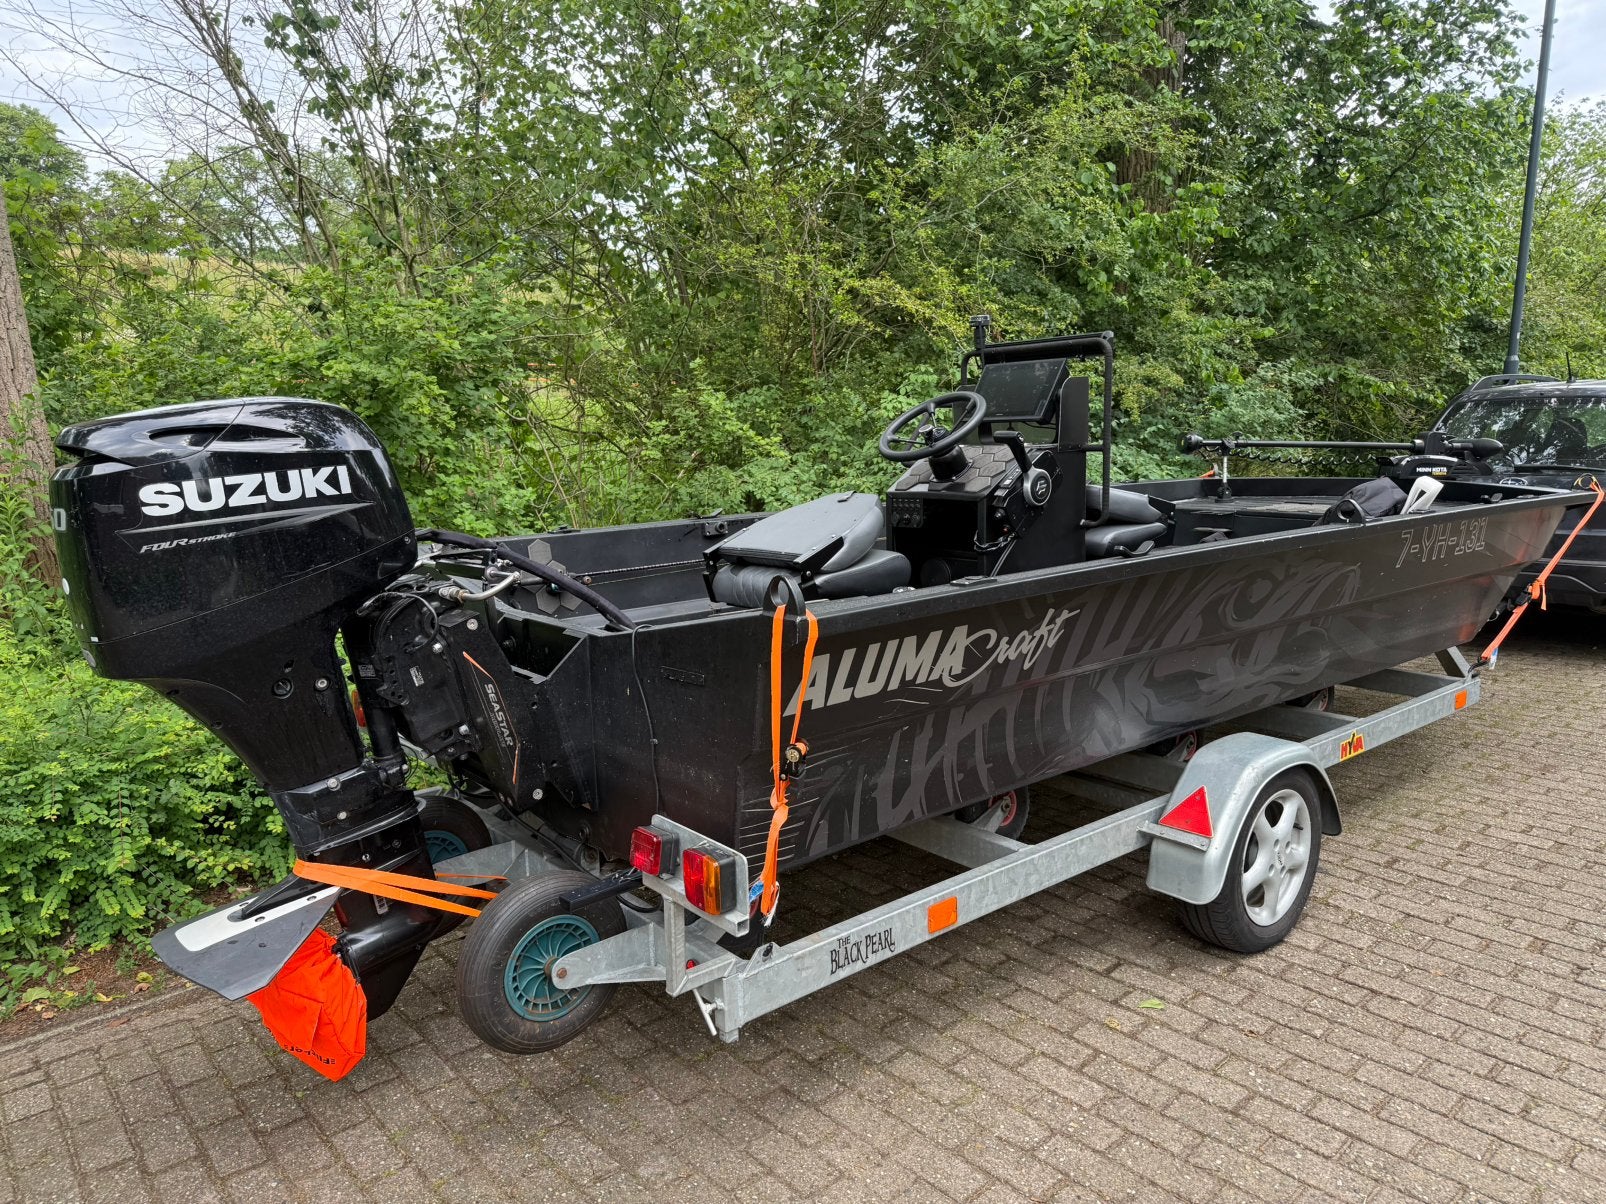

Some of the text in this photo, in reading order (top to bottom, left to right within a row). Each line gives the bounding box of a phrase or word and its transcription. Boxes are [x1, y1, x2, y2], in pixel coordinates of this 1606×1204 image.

[139, 465, 352, 517] SUZUKI
[1395, 516, 1488, 568] 7-YH-131
[484, 683, 513, 746] SEASTAR
[1341, 732, 1364, 759] HYVA
[830, 928, 896, 975] BLACK PEARL
[837, 936, 850, 949] THE
